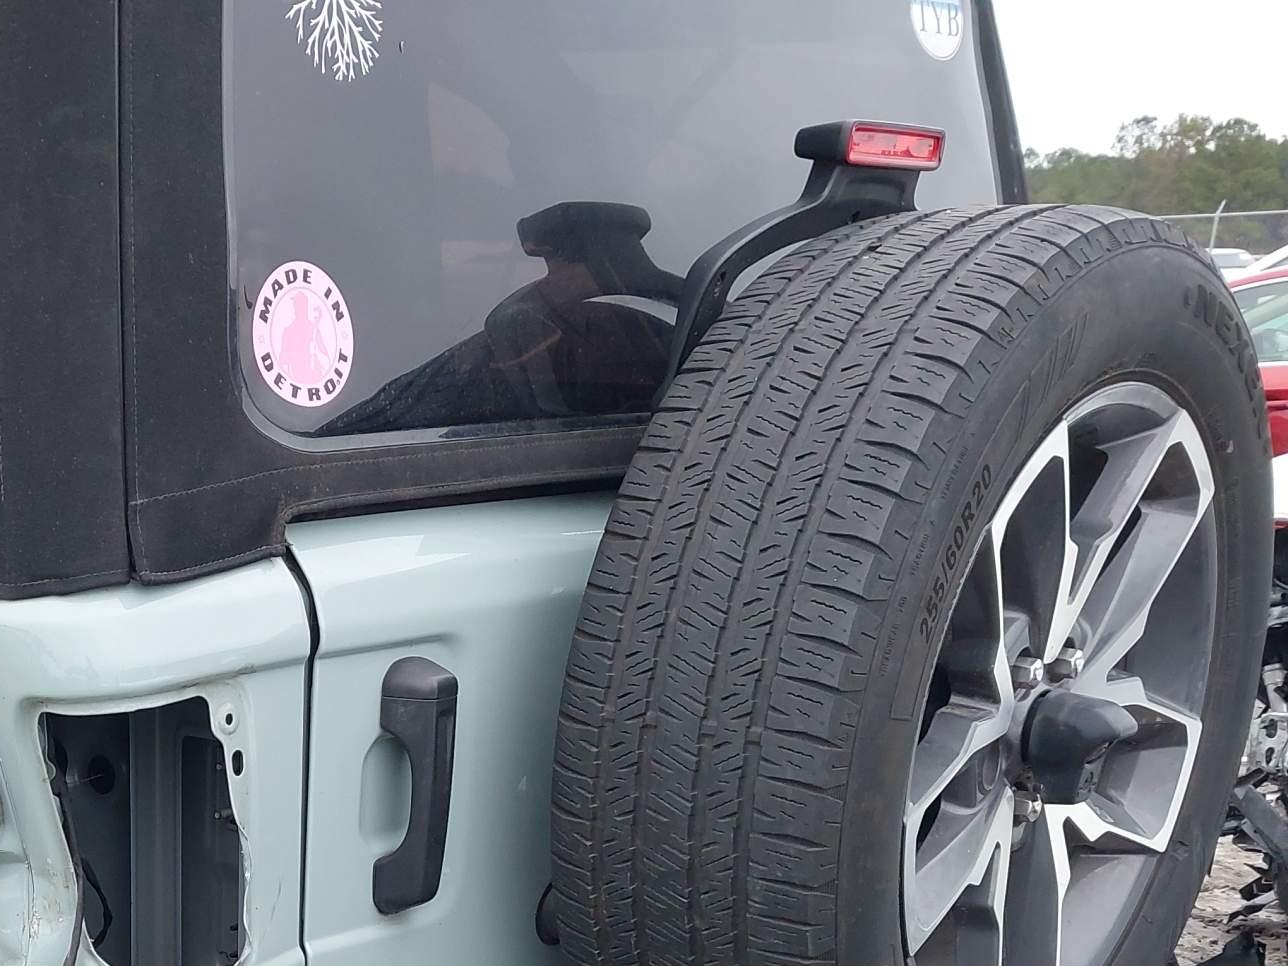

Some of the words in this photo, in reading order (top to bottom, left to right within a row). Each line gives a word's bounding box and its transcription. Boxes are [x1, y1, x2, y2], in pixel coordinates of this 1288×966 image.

[258, 268, 313, 325] MADE
[323, 286, 345, 322] IN
[260, 348, 349, 402] DETROIT
[919, 462, 993, 644] 255/60R20
